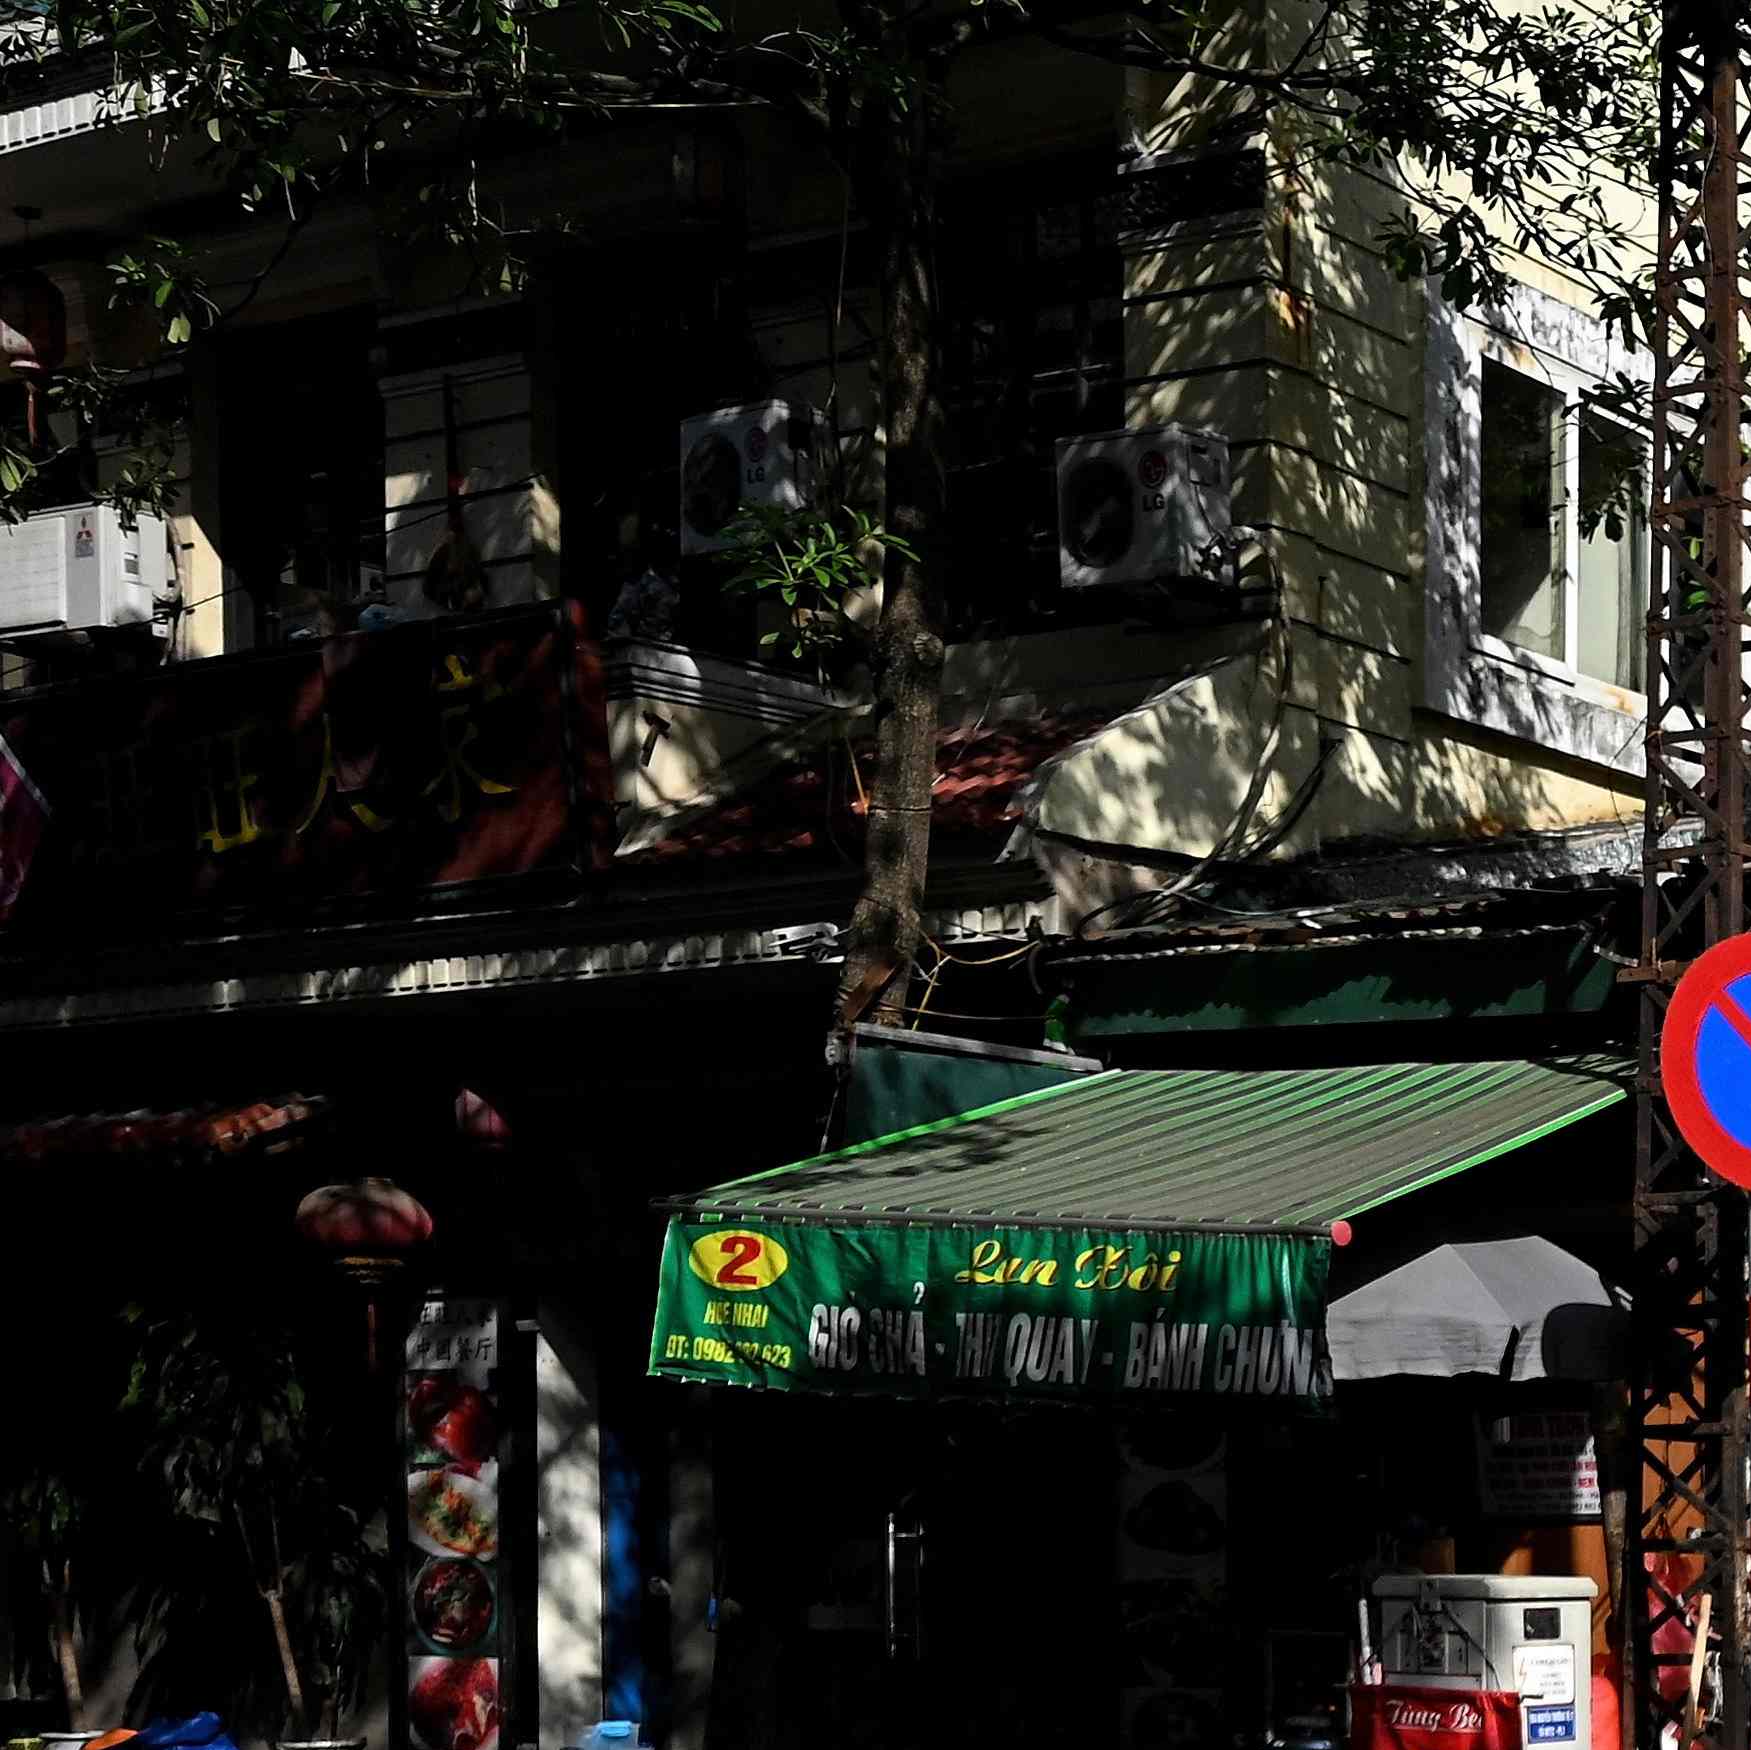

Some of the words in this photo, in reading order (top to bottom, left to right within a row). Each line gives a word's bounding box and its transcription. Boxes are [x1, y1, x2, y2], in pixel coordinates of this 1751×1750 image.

[747, 466, 765, 483] LG
[1143, 493, 1165, 511] LG
[716, 1236, 761, 1285] 2
[1073, 1243, 1185, 1293] Xôi
[732, 1302, 769, 1329] NHAI
[808, 1290, 862, 1372] GIÒ
[868, 1281, 927, 1376] CHẢ
[1003, 1311, 1101, 1389] QUAY
[1122, 1306, 1209, 1393] BÁNH
[1384, 1699, 1442, 1732] Tùng
